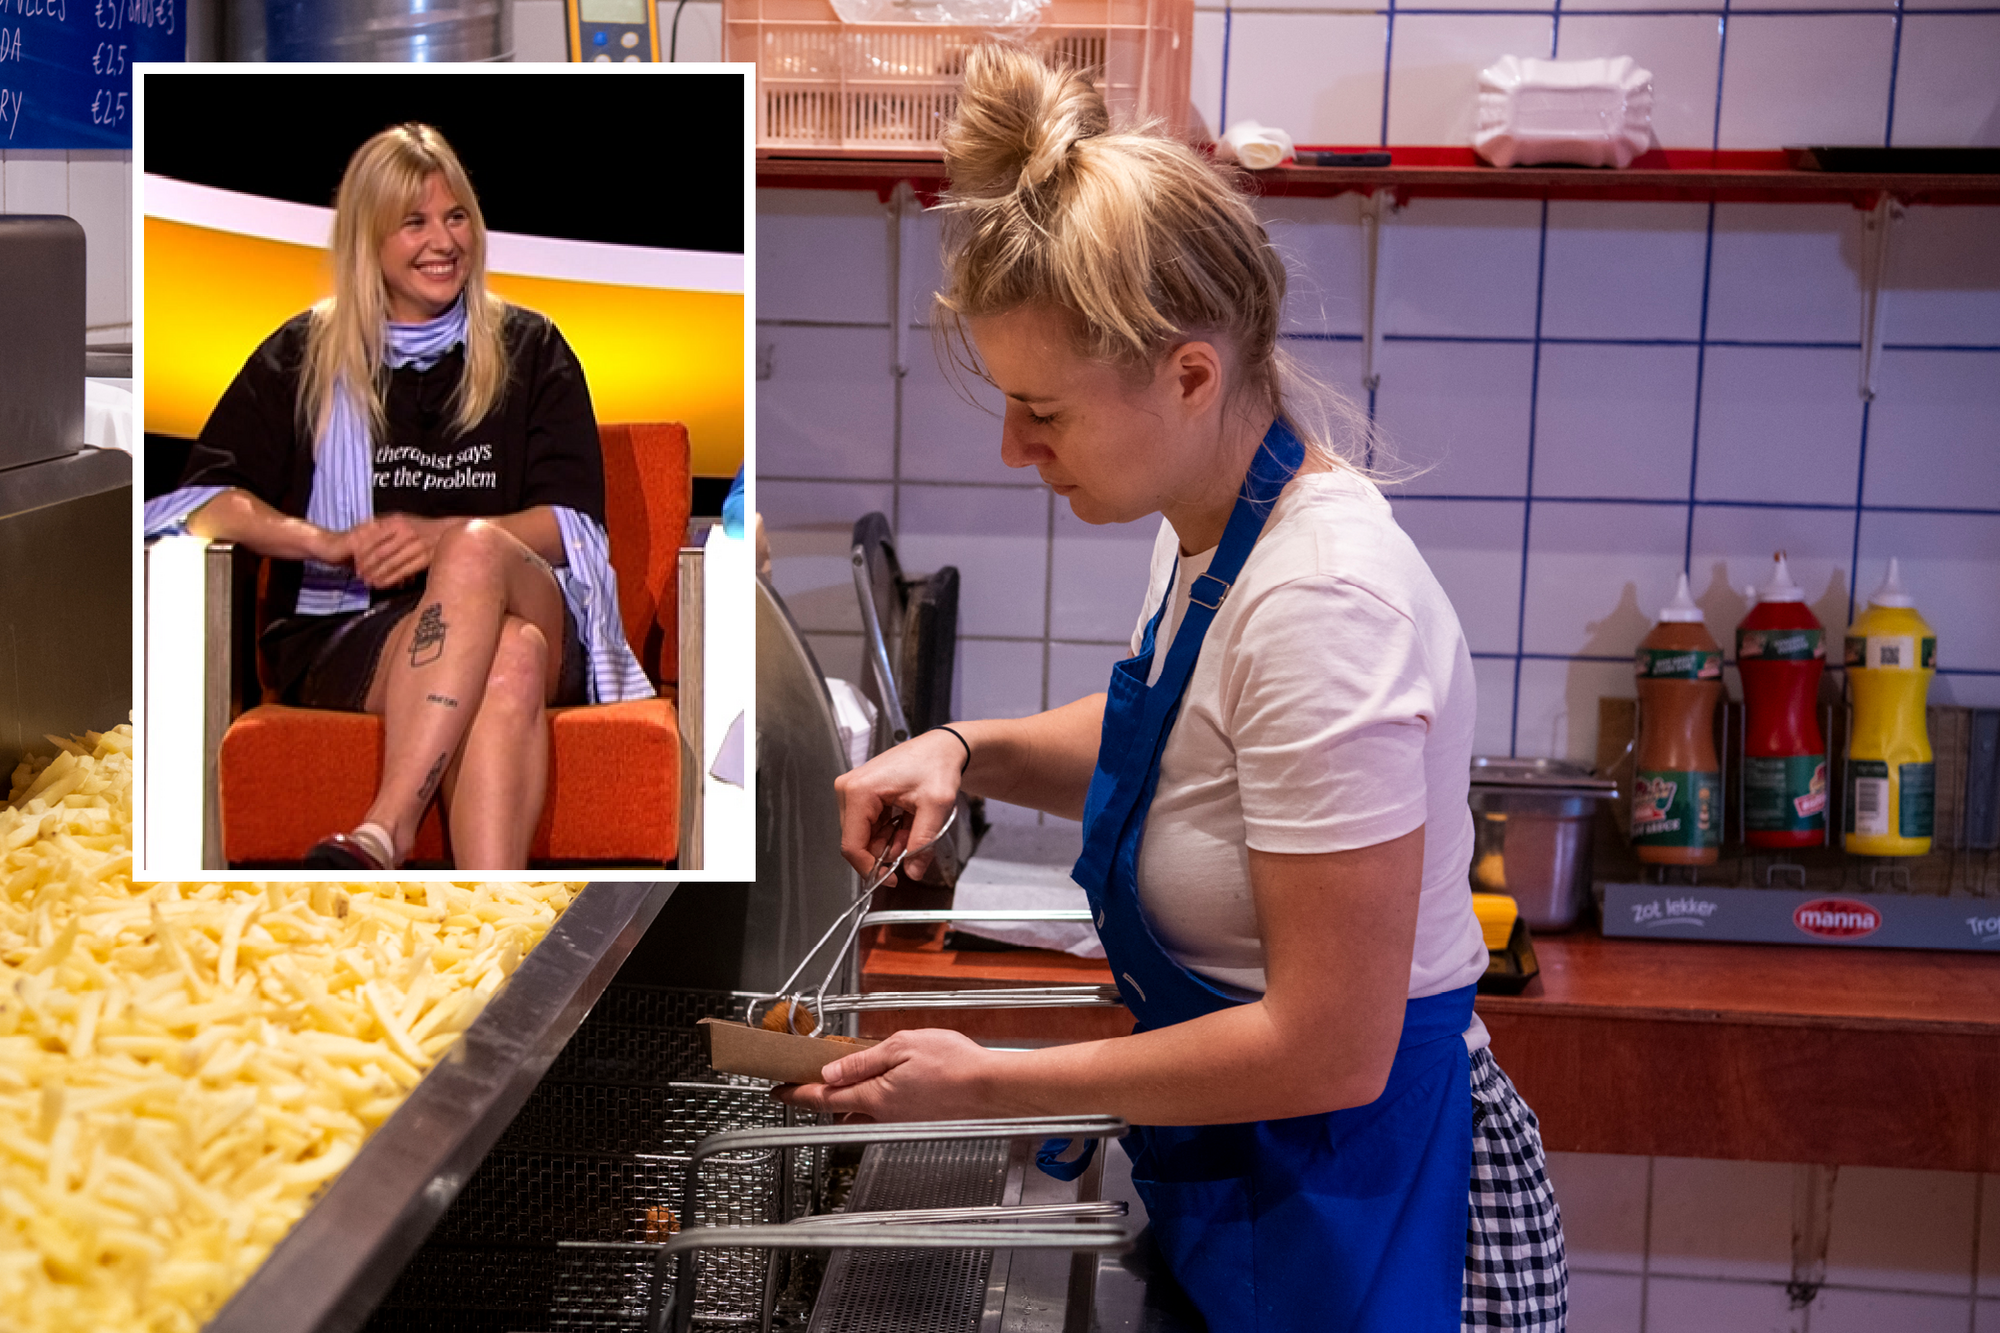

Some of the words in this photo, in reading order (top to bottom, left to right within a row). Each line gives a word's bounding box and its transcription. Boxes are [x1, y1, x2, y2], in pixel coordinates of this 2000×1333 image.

[92, 42, 127, 76] €2,5
[91, 89, 128, 127] €2,5
[454, 443, 493, 466] says
[394, 465, 423, 488] the
[423, 466, 497, 491] problem
[1665, 896, 1718, 917] lekker
[1799, 910, 1875, 930] manna
[1965, 915, 2000, 936] Tro
